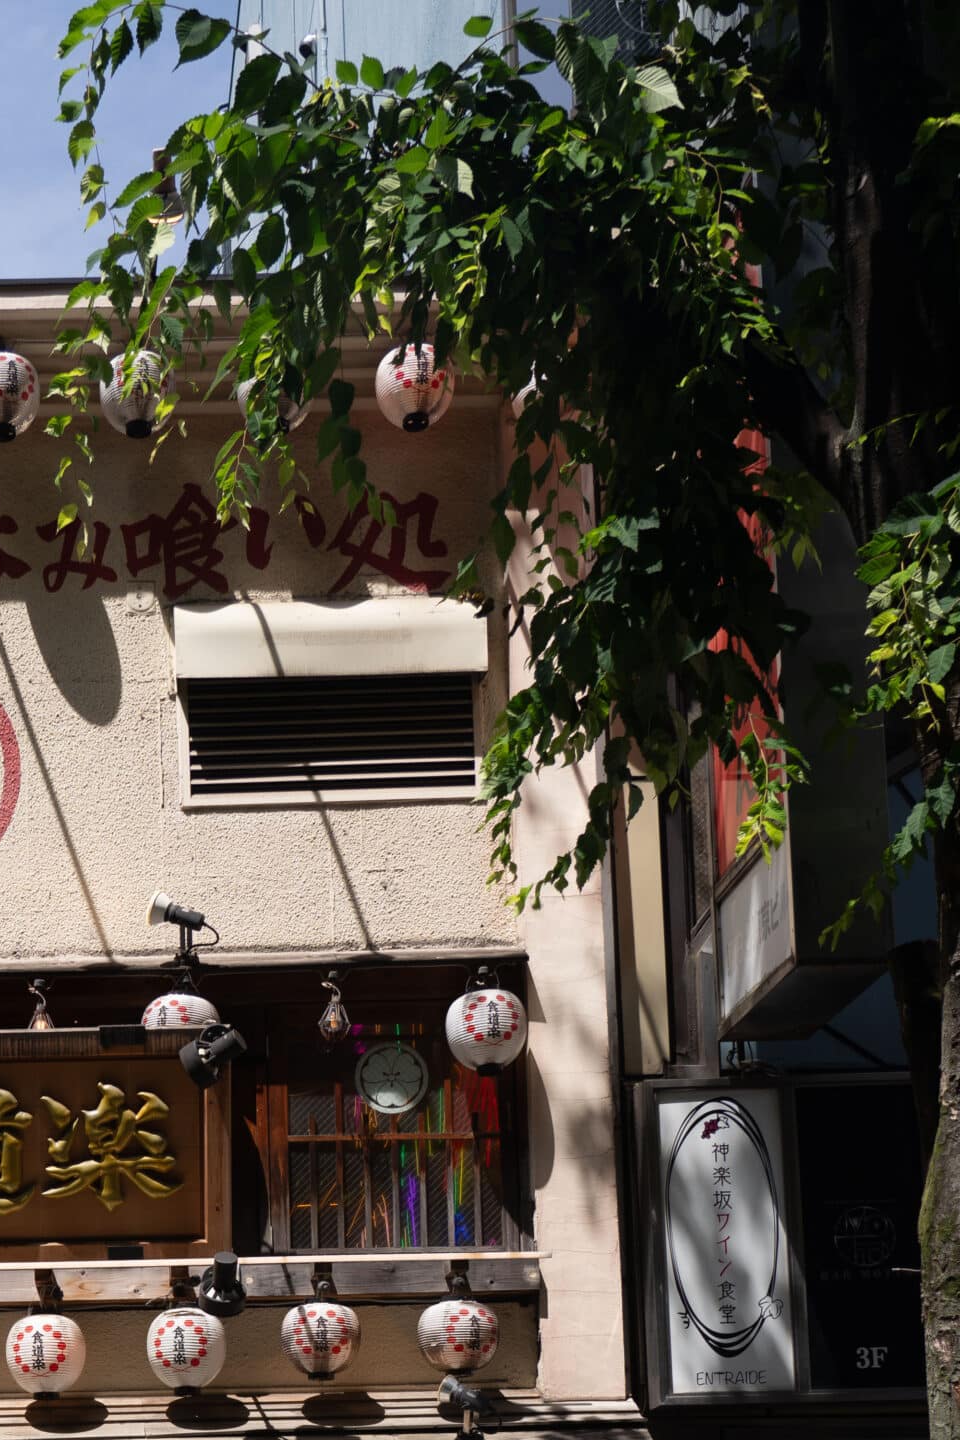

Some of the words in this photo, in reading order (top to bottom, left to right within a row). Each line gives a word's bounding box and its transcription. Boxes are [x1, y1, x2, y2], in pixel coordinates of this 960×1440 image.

[486, 999, 501, 1038] 食道楽
[711, 1142, 736, 1325] 神楽坂ワイン食堂
[31, 1330, 46, 1371] 食道楽
[173, 1326, 187, 1365] 食道楽
[315, 1315, 329, 1352] 食道楽
[469, 1314, 481, 1351] 食道楽
[855, 1346, 888, 1369] 3F
[696, 1370, 767, 1386] ENTRAIDE
